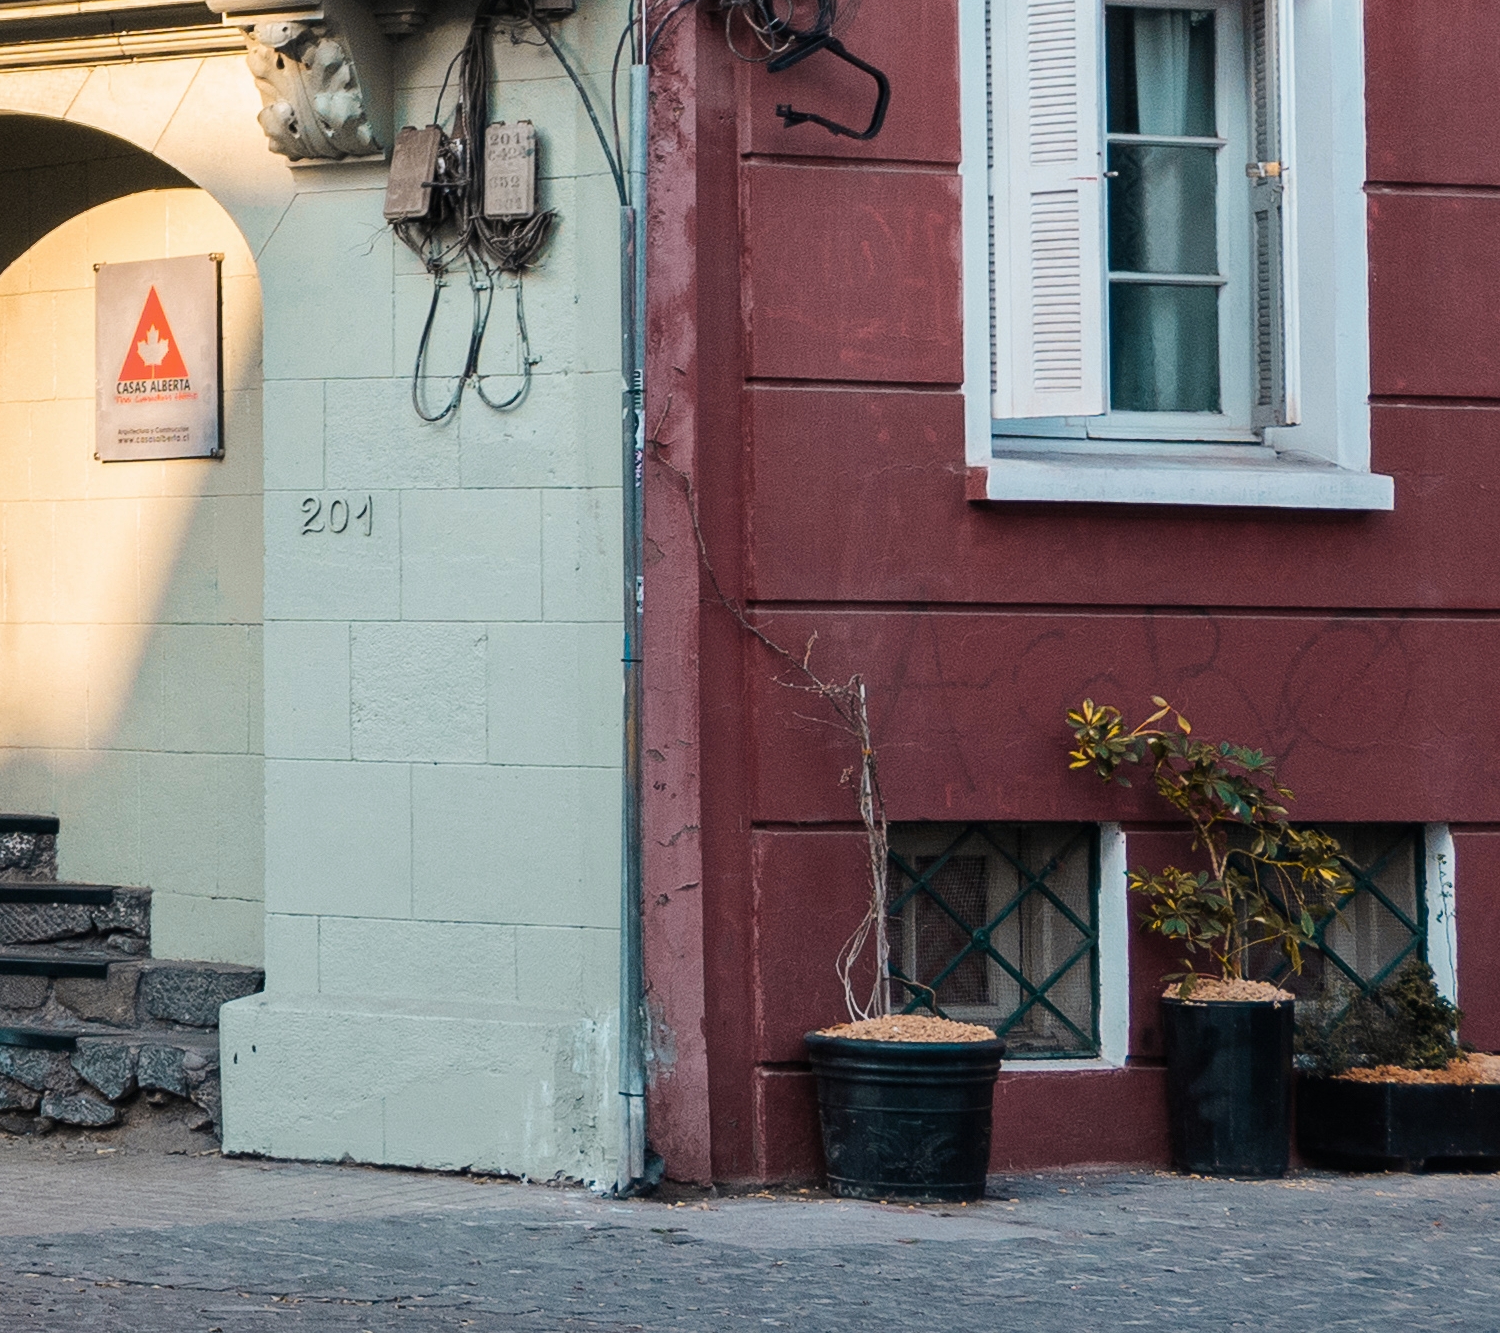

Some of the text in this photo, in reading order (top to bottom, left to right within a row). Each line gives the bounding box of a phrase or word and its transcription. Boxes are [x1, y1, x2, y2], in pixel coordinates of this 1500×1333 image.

[490, 133, 521, 146] 201
[116, 378, 191, 395] CASAS ALBERTA
[301, 494, 374, 537] 201
